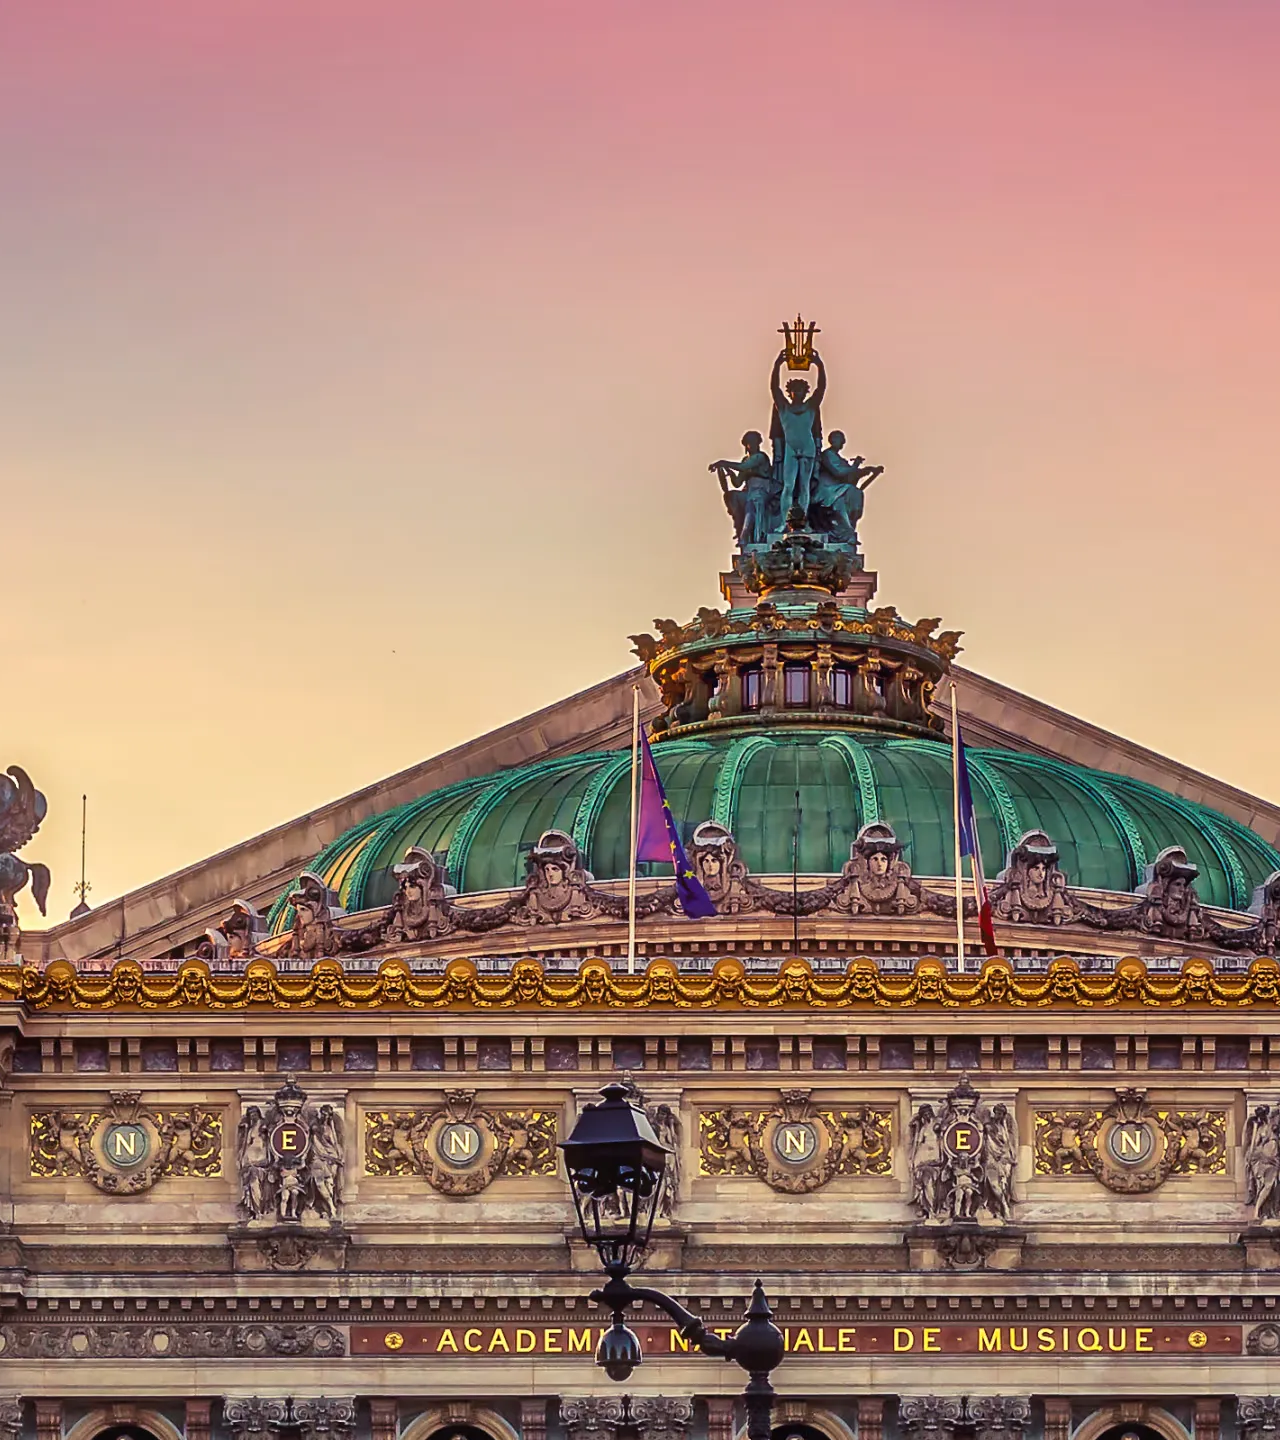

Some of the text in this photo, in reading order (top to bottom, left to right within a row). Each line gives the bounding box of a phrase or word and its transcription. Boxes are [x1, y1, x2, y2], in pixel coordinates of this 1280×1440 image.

[114, 1131, 137, 1157] N
[281, 1129, 297, 1151] E
[449, 1130, 472, 1155] N
[784, 1129, 807, 1154] N
[955, 1129, 971, 1150] E
[1120, 1129, 1142, 1154] N
[436, 1328, 606, 1352] ACADEM
[893, 1327, 941, 1351] DE
[978, 1327, 1154, 1352] MUSIQUE
